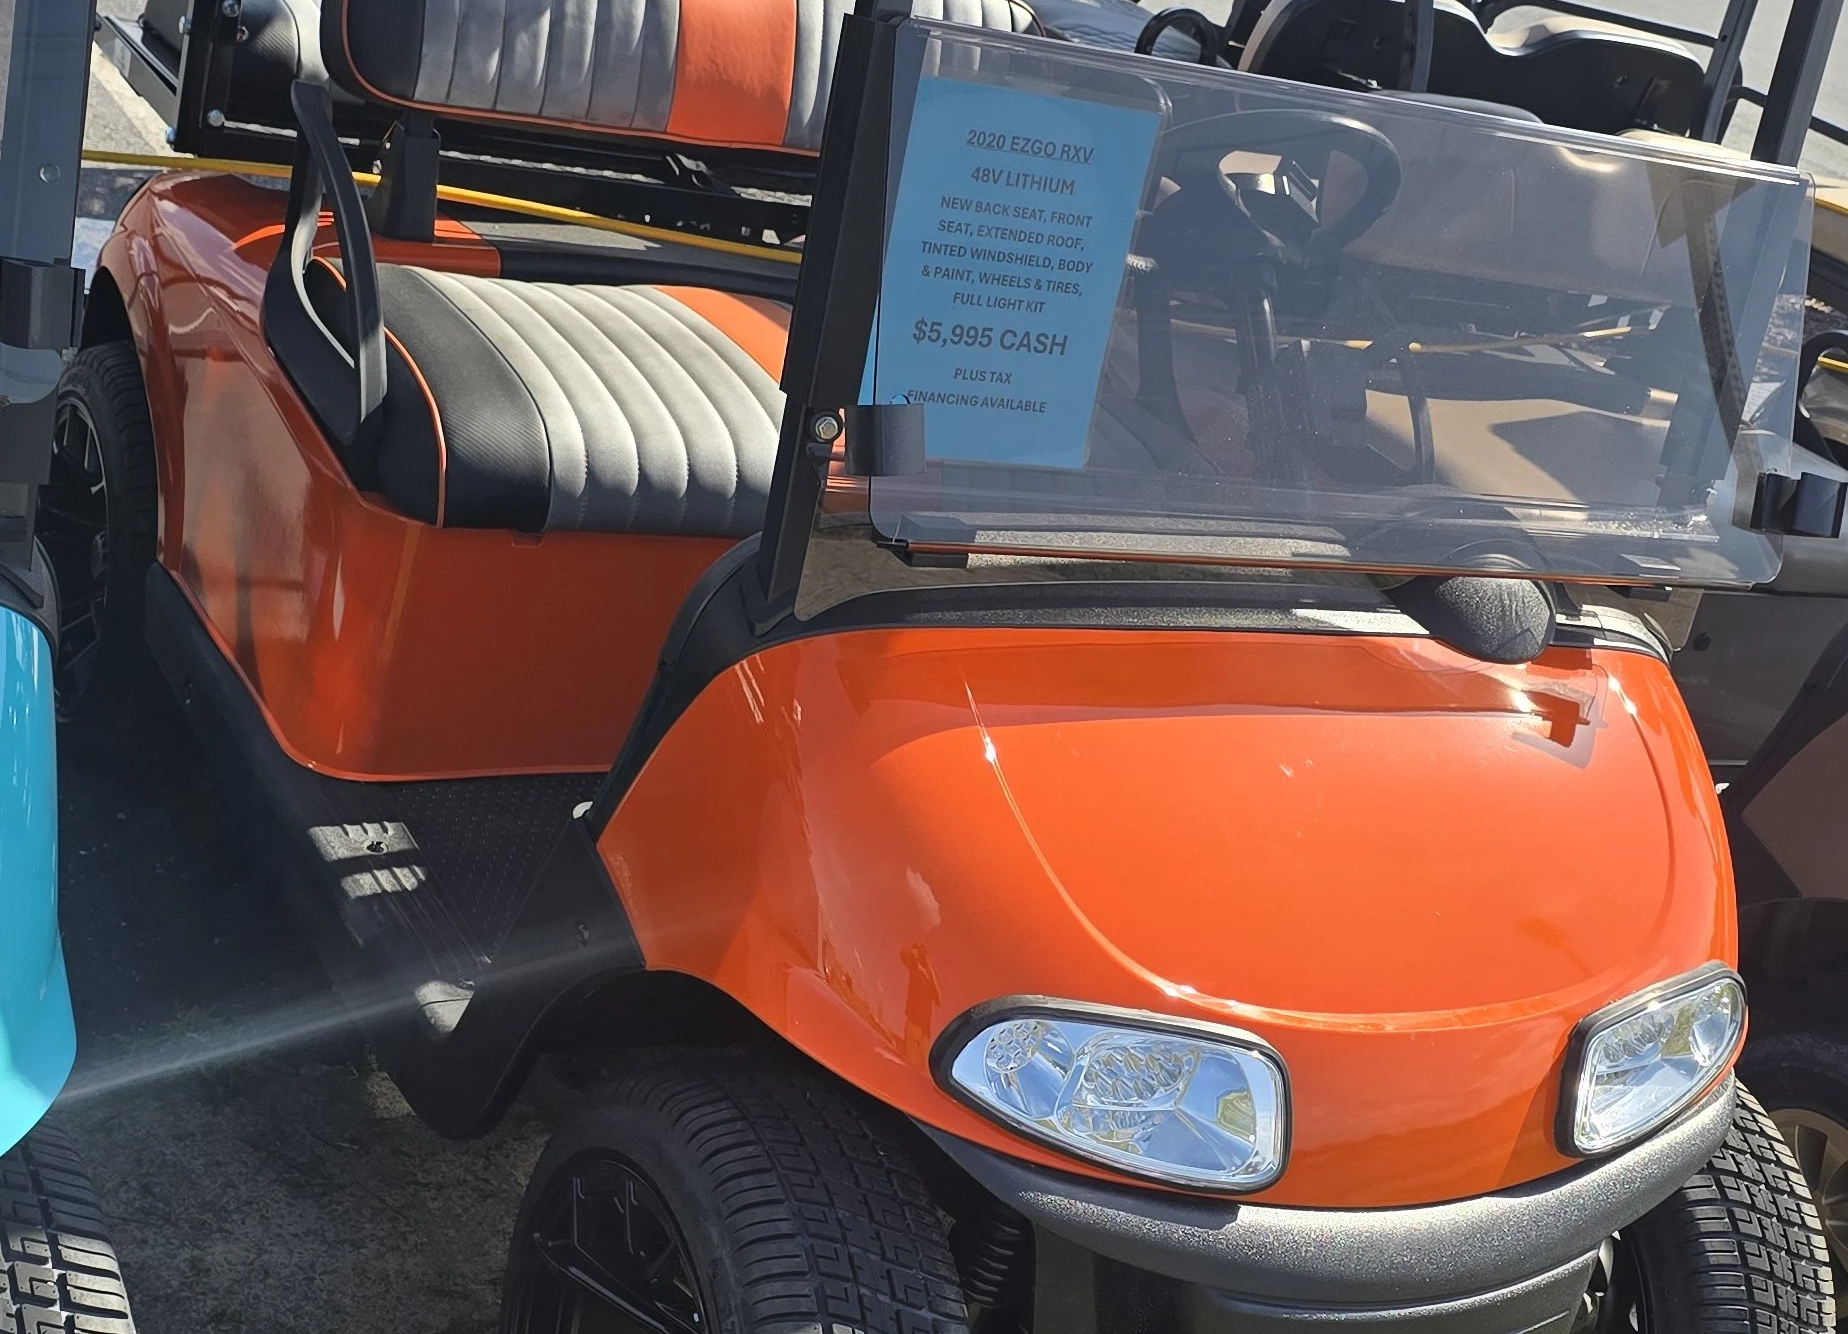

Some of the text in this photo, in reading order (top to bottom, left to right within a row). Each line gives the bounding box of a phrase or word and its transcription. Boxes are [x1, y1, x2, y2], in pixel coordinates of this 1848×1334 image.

[966, 129, 1095, 165] 2020 EZGO RXV
[970, 166, 1076, 196] 48V LITHIUM
[940, 195, 1093, 228] NEW BACK SEAT, FRONT
[937, 219, 1085, 252] SEAT, EXTENDED ROOF,
[921, 240, 1094, 274] TINTED WINDSHIELD, BODY
[921, 264, 1083, 297] & PAINT, WHEELS & TIRES,
[952, 291, 1047, 314] FULL LIGHT KIT
[912, 316, 1069, 356] $5,995 CASH
[953, 367, 1013, 385] PLUS TAX
[907, 389, 1048, 414] FINANCING AVAILABLE
